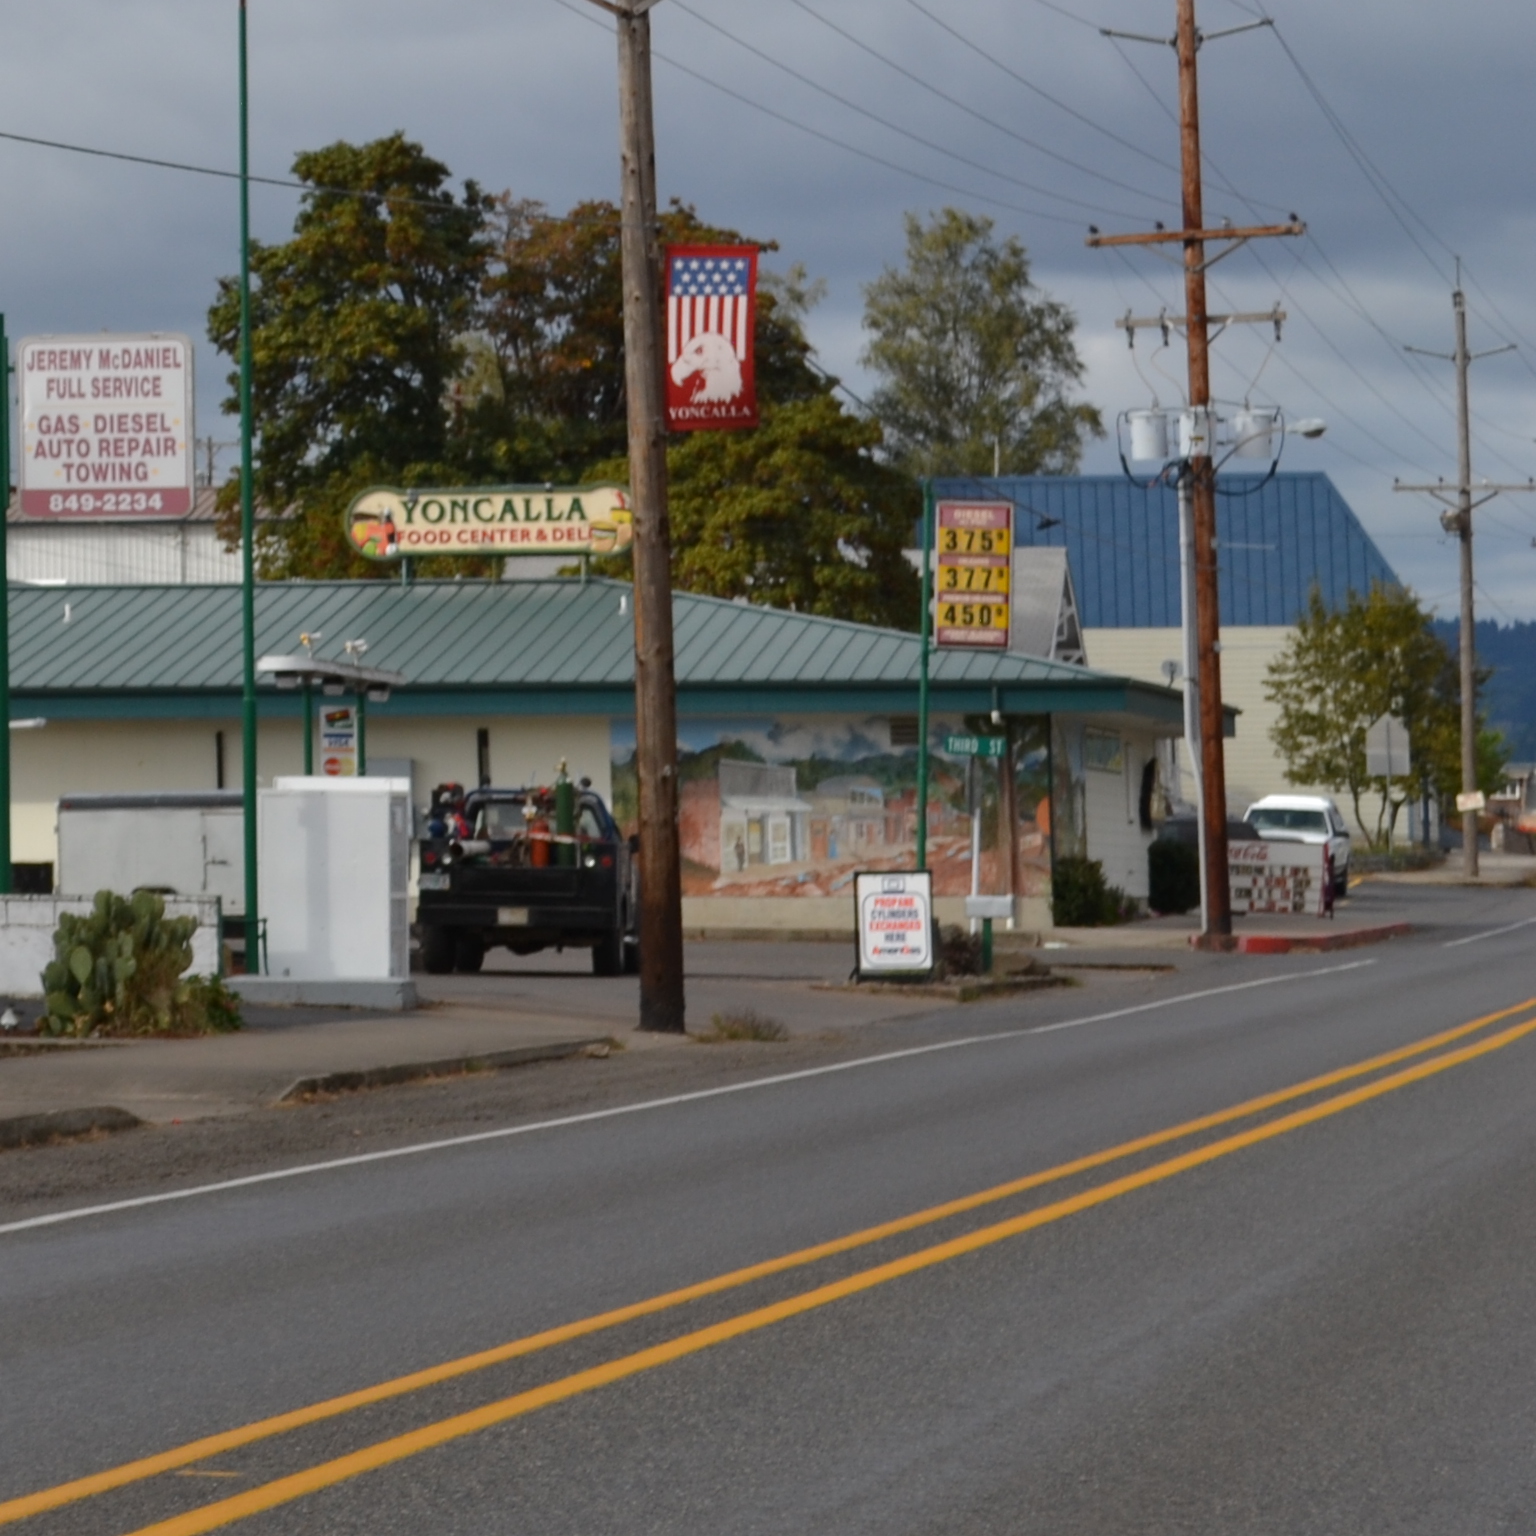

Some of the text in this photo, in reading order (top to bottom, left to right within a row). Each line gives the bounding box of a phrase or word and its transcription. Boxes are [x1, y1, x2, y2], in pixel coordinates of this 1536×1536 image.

[27, 347, 181, 371] JEREMY McDANIEL
[46, 376, 162, 399] FULL SERVICE
[669, 406, 751, 420] YONCALLA
[38, 413, 171, 434] GAS DIESEL
[34, 437, 177, 459] AUTO REPAIR
[62, 462, 148, 482] TOWING
[49, 493, 163, 512] 849-2234
[400, 497, 587, 523] YONCALLA
[396, 529, 451, 544] FOOD
[456, 529, 530, 544] CENTER
[536, 527, 547, 541] &
[948, 736, 1002, 755] THIRD ST
[874, 897, 915, 907] PROPANE
[871, 909, 919, 919] CYLINDERS
[869, 920, 922, 931] EXCHANGED
[884, 932, 906, 942] HERE
